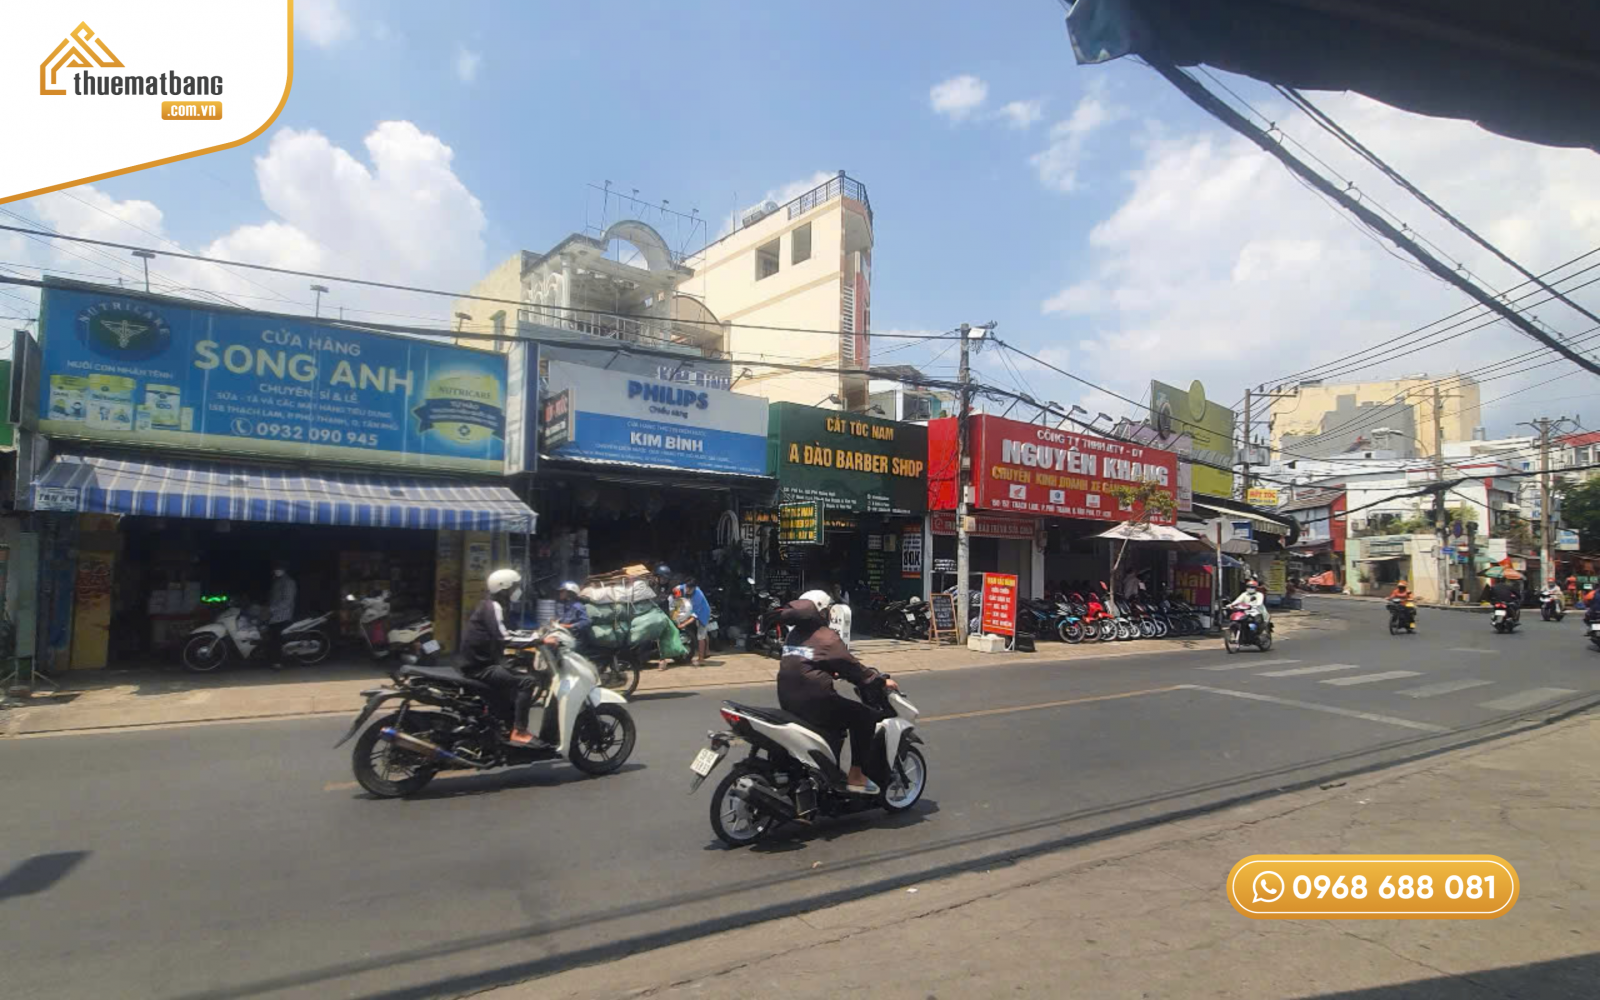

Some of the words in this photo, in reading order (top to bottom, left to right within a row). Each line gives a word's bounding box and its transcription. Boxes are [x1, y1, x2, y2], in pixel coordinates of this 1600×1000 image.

[78, 301, 170, 336] NUTRICARE
[261, 326, 302, 348] CỬA
[309, 337, 360, 357] HÀNG
[194, 339, 318, 382] SONG
[330, 360, 413, 396] ANH
[440, 386, 491, 399] NUTRICARE
[627, 379, 709, 410] PHILIPS
[257, 422, 303, 440] 0932
[309, 428, 342, 443] 090
[347, 433, 378, 447] 945
[630, 431, 661, 447] KIM
[665, 433, 703, 452] BÌNH
[826, 414, 846, 433] CẮT
[850, 420, 869, 437] TÓC
[872, 425, 894, 441] NAM
[1037, 429, 1065, 444] CÔNG
[1067, 435, 1080, 447] TY
[789, 442, 799, 464] A
[835, 449, 888, 474] BARBER
[892, 457, 923, 478] SHOP
[1103, 456, 1169, 487] KHANG
[992, 465, 1031, 483] CHUYÊN
[1035, 473, 1057, 486] KINH
[1058, 475, 1088, 490] DOANH
[1091, 481, 1101, 492] XE
